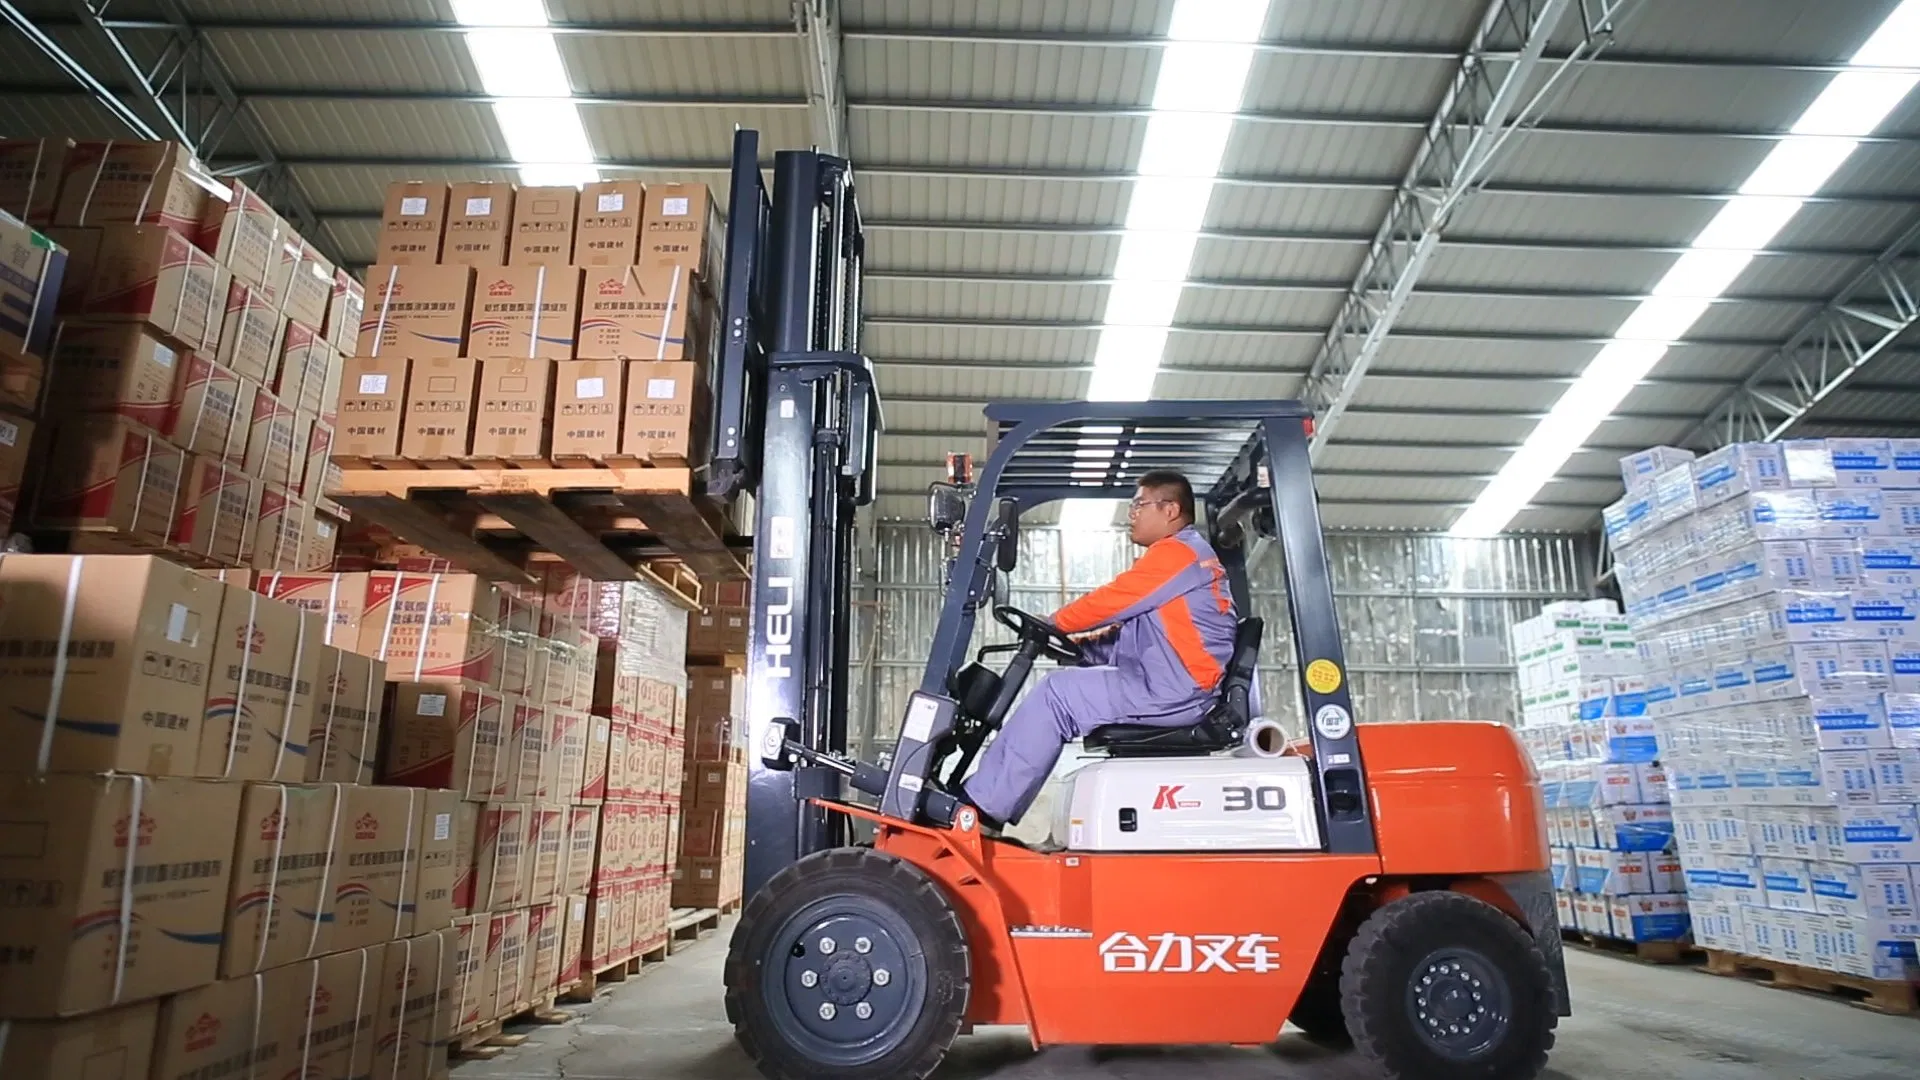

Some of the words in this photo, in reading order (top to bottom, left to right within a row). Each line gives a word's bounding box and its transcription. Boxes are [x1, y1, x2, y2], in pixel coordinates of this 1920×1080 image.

[765, 576, 793, 678] HELI
[1152, 785, 1184, 810] K
[1222, 786, 1287, 811] 30
[1099, 931, 1280, 973] 合力叉车
